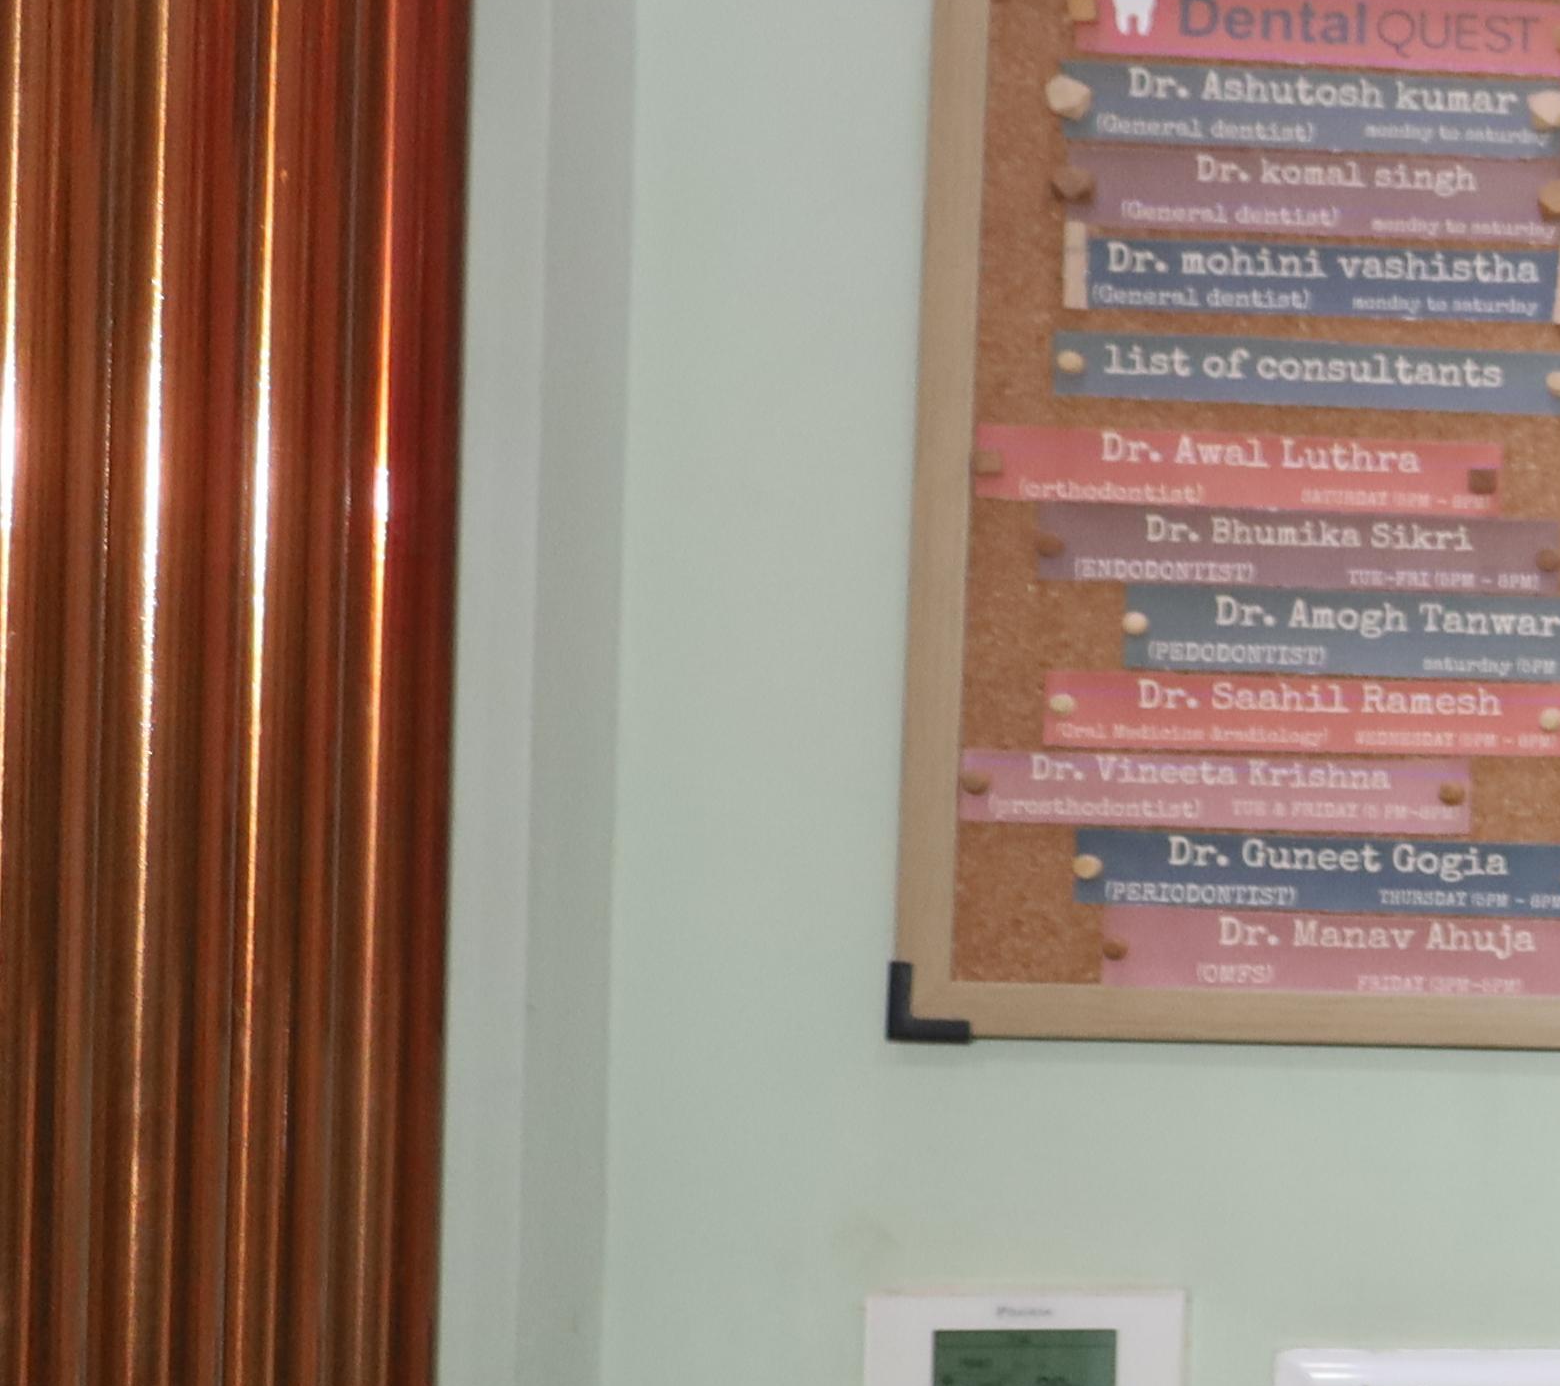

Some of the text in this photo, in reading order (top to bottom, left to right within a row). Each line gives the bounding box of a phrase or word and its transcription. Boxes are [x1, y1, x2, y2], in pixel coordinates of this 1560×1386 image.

[1128, 69, 1517, 116] Dr. Ashutosh kumar
[1197, 155, 1477, 196] Dr. komal singh
[1107, 241, 1540, 283] Dr. mohini vashistha
[1103, 344, 1504, 389] list of consultants
[1101, 434, 1421, 475] Dr. Awal Luthra
[1145, 515, 1473, 553] Dr. Bhumika Sikri
[1214, 594, 1276, 627] Dr.
[1288, 598, 1408, 639] Amogh
[1139, 682, 1501, 717] Dr. Saahil Ramesh
[1031, 755, 1390, 791] Dr. Vineeta Krishna
[1169, 838, 1507, 881] Dr. Guneet Gogia
[1218, 917, 1536, 957] Dr. Manav Ahuja
